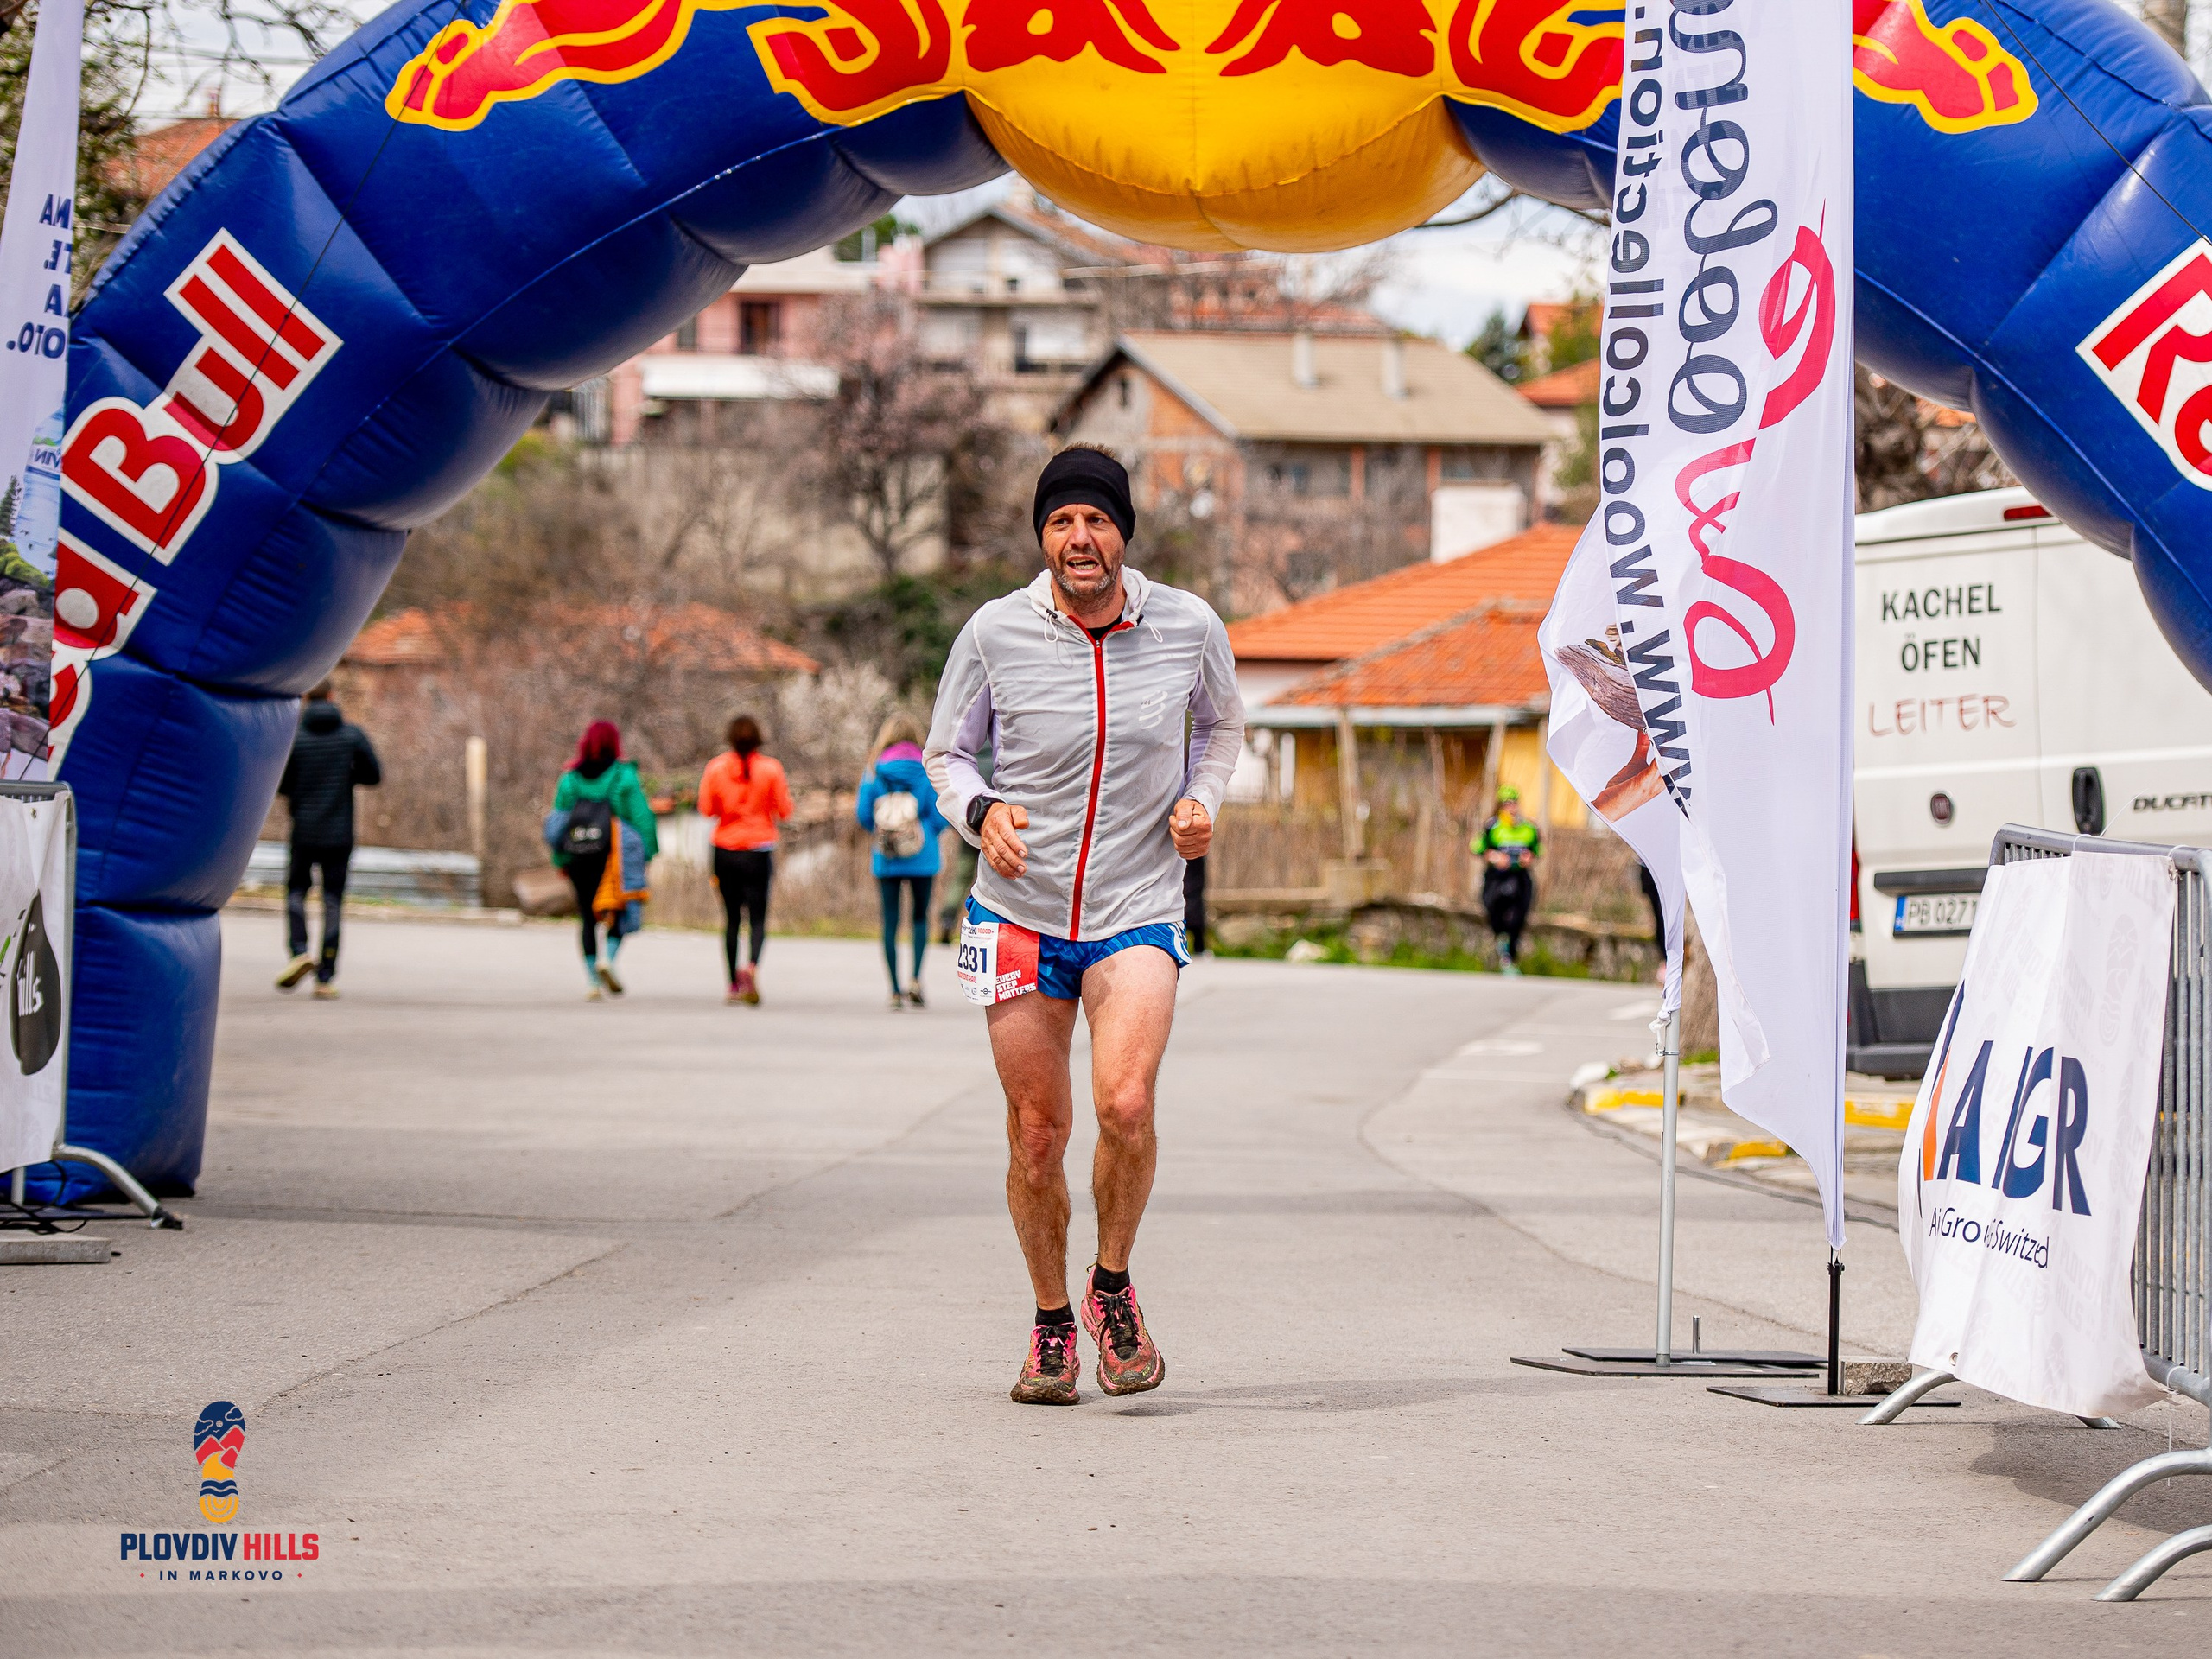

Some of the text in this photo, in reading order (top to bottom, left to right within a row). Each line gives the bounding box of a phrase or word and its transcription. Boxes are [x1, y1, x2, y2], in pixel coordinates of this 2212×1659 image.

[61, 237, 334, 556] Bull
[1881, 584, 2002, 622] KACHEL
[1900, 633, 1980, 671] ÖFEN
[1868, 694, 2017, 737] LEITER
[2133, 793, 2212, 812] DUCAT
[957, 943, 988, 974] 2331
[996, 969, 1021, 984] EVERY
[996, 980, 1018, 993] STEP
[998, 982, 1037, 1001] MATTERS
